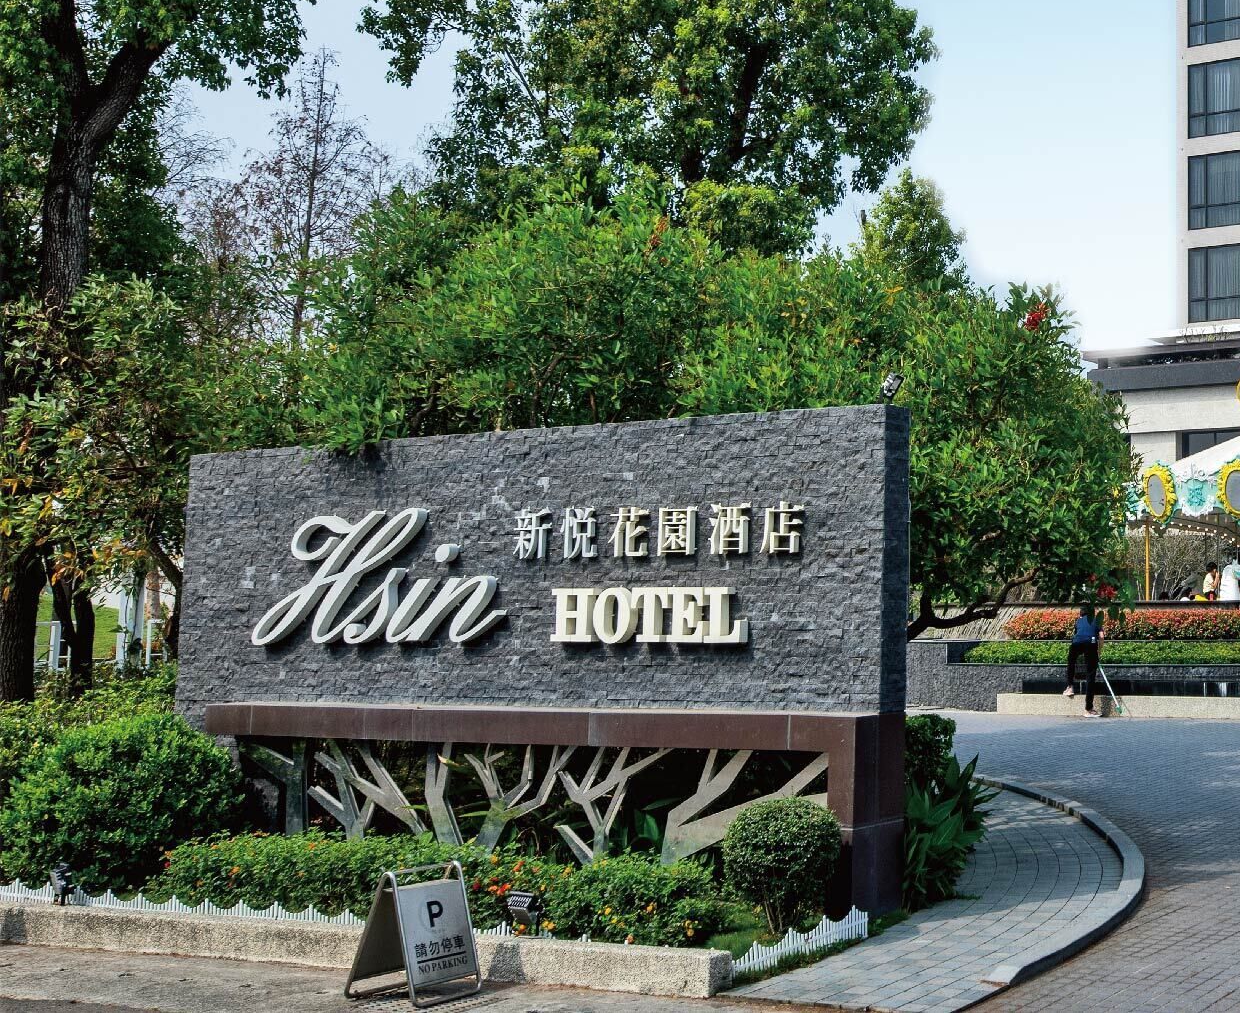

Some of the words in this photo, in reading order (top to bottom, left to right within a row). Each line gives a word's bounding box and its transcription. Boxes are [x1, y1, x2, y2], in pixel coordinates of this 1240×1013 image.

[513, 501, 804, 559] 新悦花園酒店
[251, 508, 507, 645] Hsin
[550, 587, 748, 644] HOTEL
[426, 900, 443, 927] P
[415, 935, 465, 958] 請勿停車
[418, 964, 430, 974] NO
[431, 956, 468, 972] PARKING
